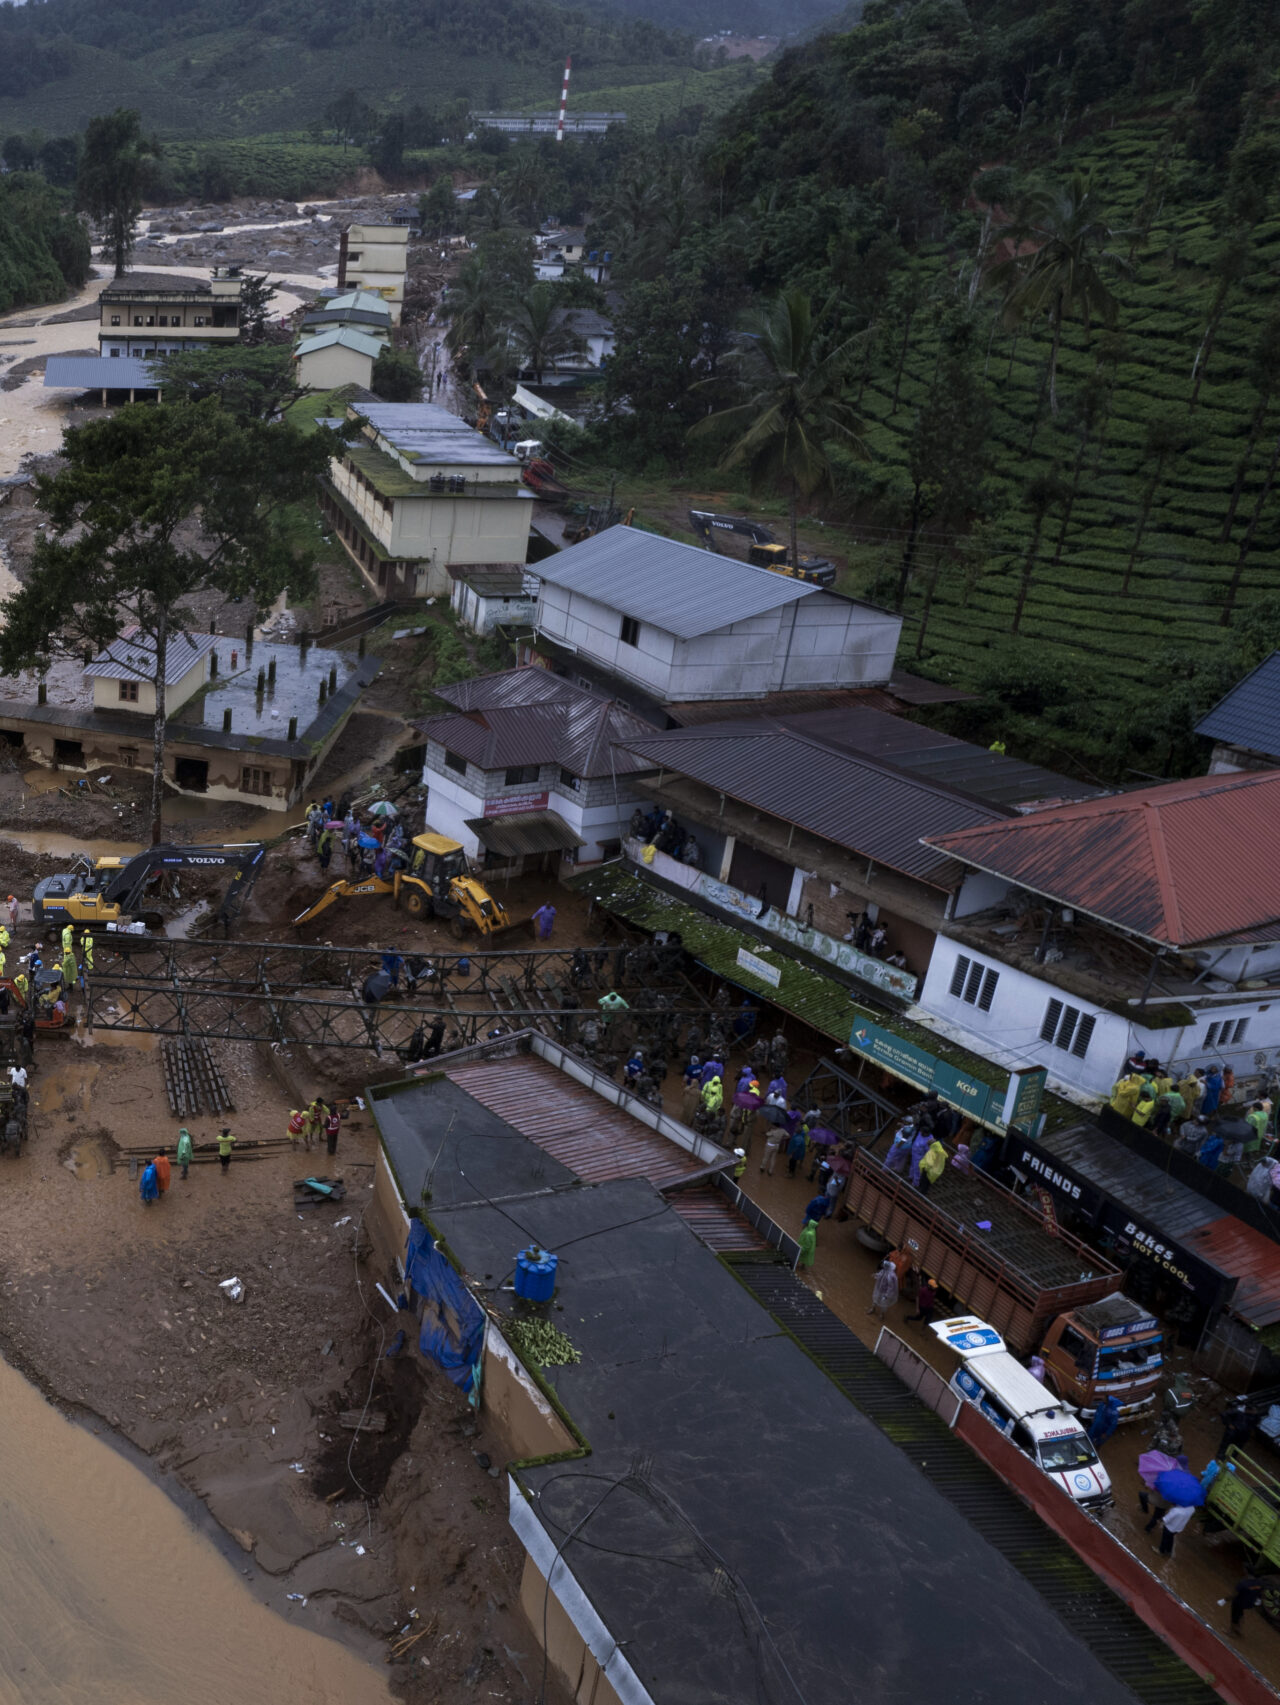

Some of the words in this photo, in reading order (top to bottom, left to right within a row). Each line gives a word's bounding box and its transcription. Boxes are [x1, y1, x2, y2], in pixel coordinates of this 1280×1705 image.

[187, 857, 225, 865] VOLVO
[354, 885, 375, 893] JCB
[873, 1043, 894, 1058] Kerala
[894, 1053, 917, 1071] Gramin
[917, 1066, 934, 1081] Bank
[956, 1079, 979, 1097] KGB
[1022, 1151, 1082, 1200] FRIENDS
[1124, 1221, 1174, 1261] Bakes
[1132, 1240, 1152, 1257] HOT
[1153, 1255, 1160, 1263] &
[1162, 1260, 1189, 1284] COOL
